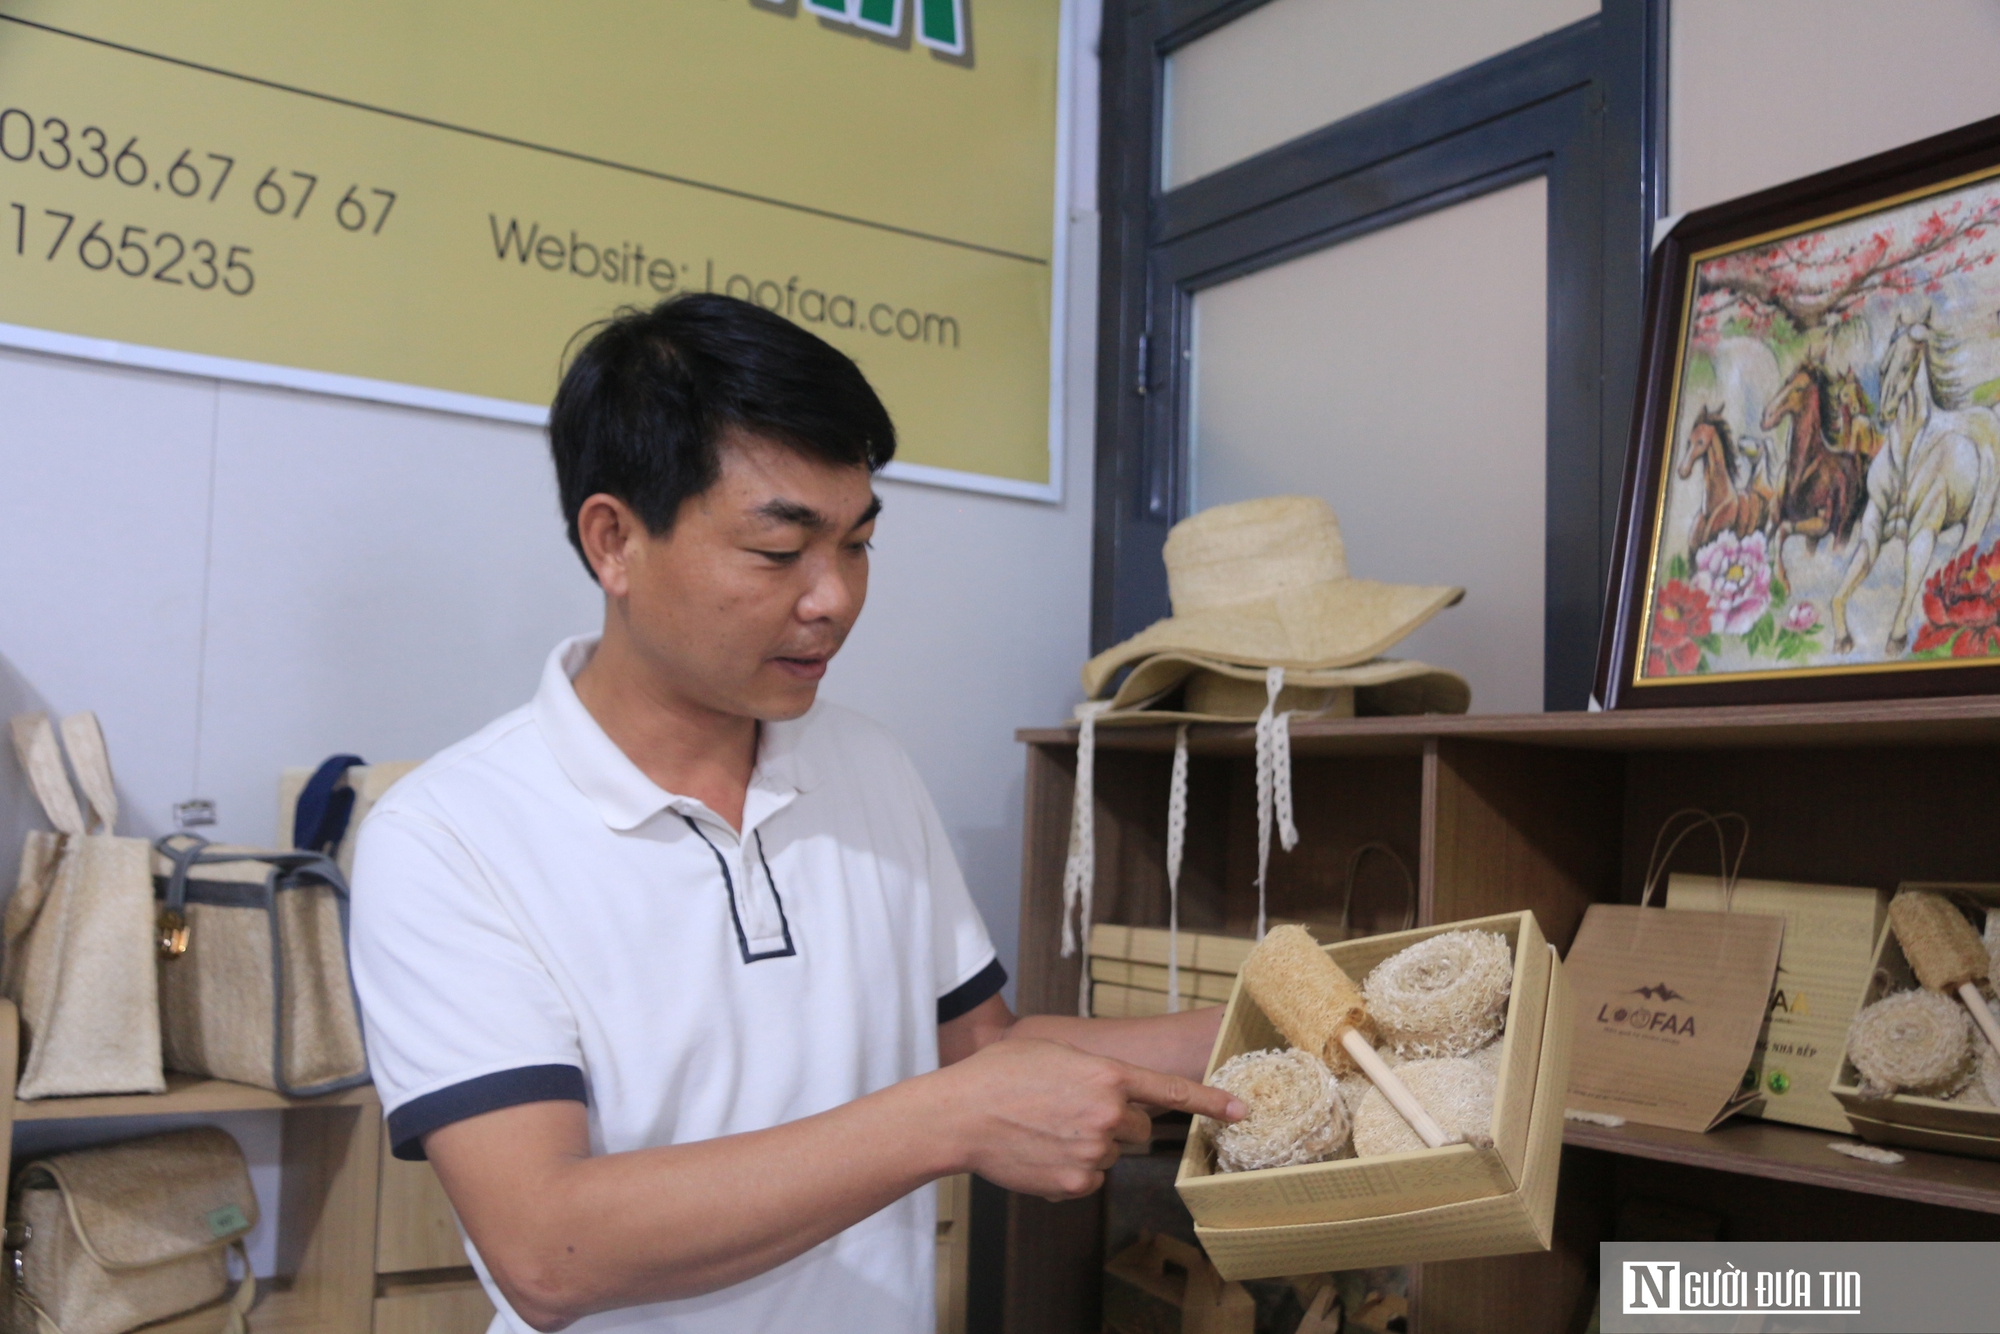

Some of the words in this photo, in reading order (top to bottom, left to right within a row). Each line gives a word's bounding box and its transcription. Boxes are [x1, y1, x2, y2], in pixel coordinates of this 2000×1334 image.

[0, 108, 235, 202] 0336.67
[254, 167, 318, 219] 67
[336, 184, 397, 236] 67
[11, 203, 255, 295] 1765235
